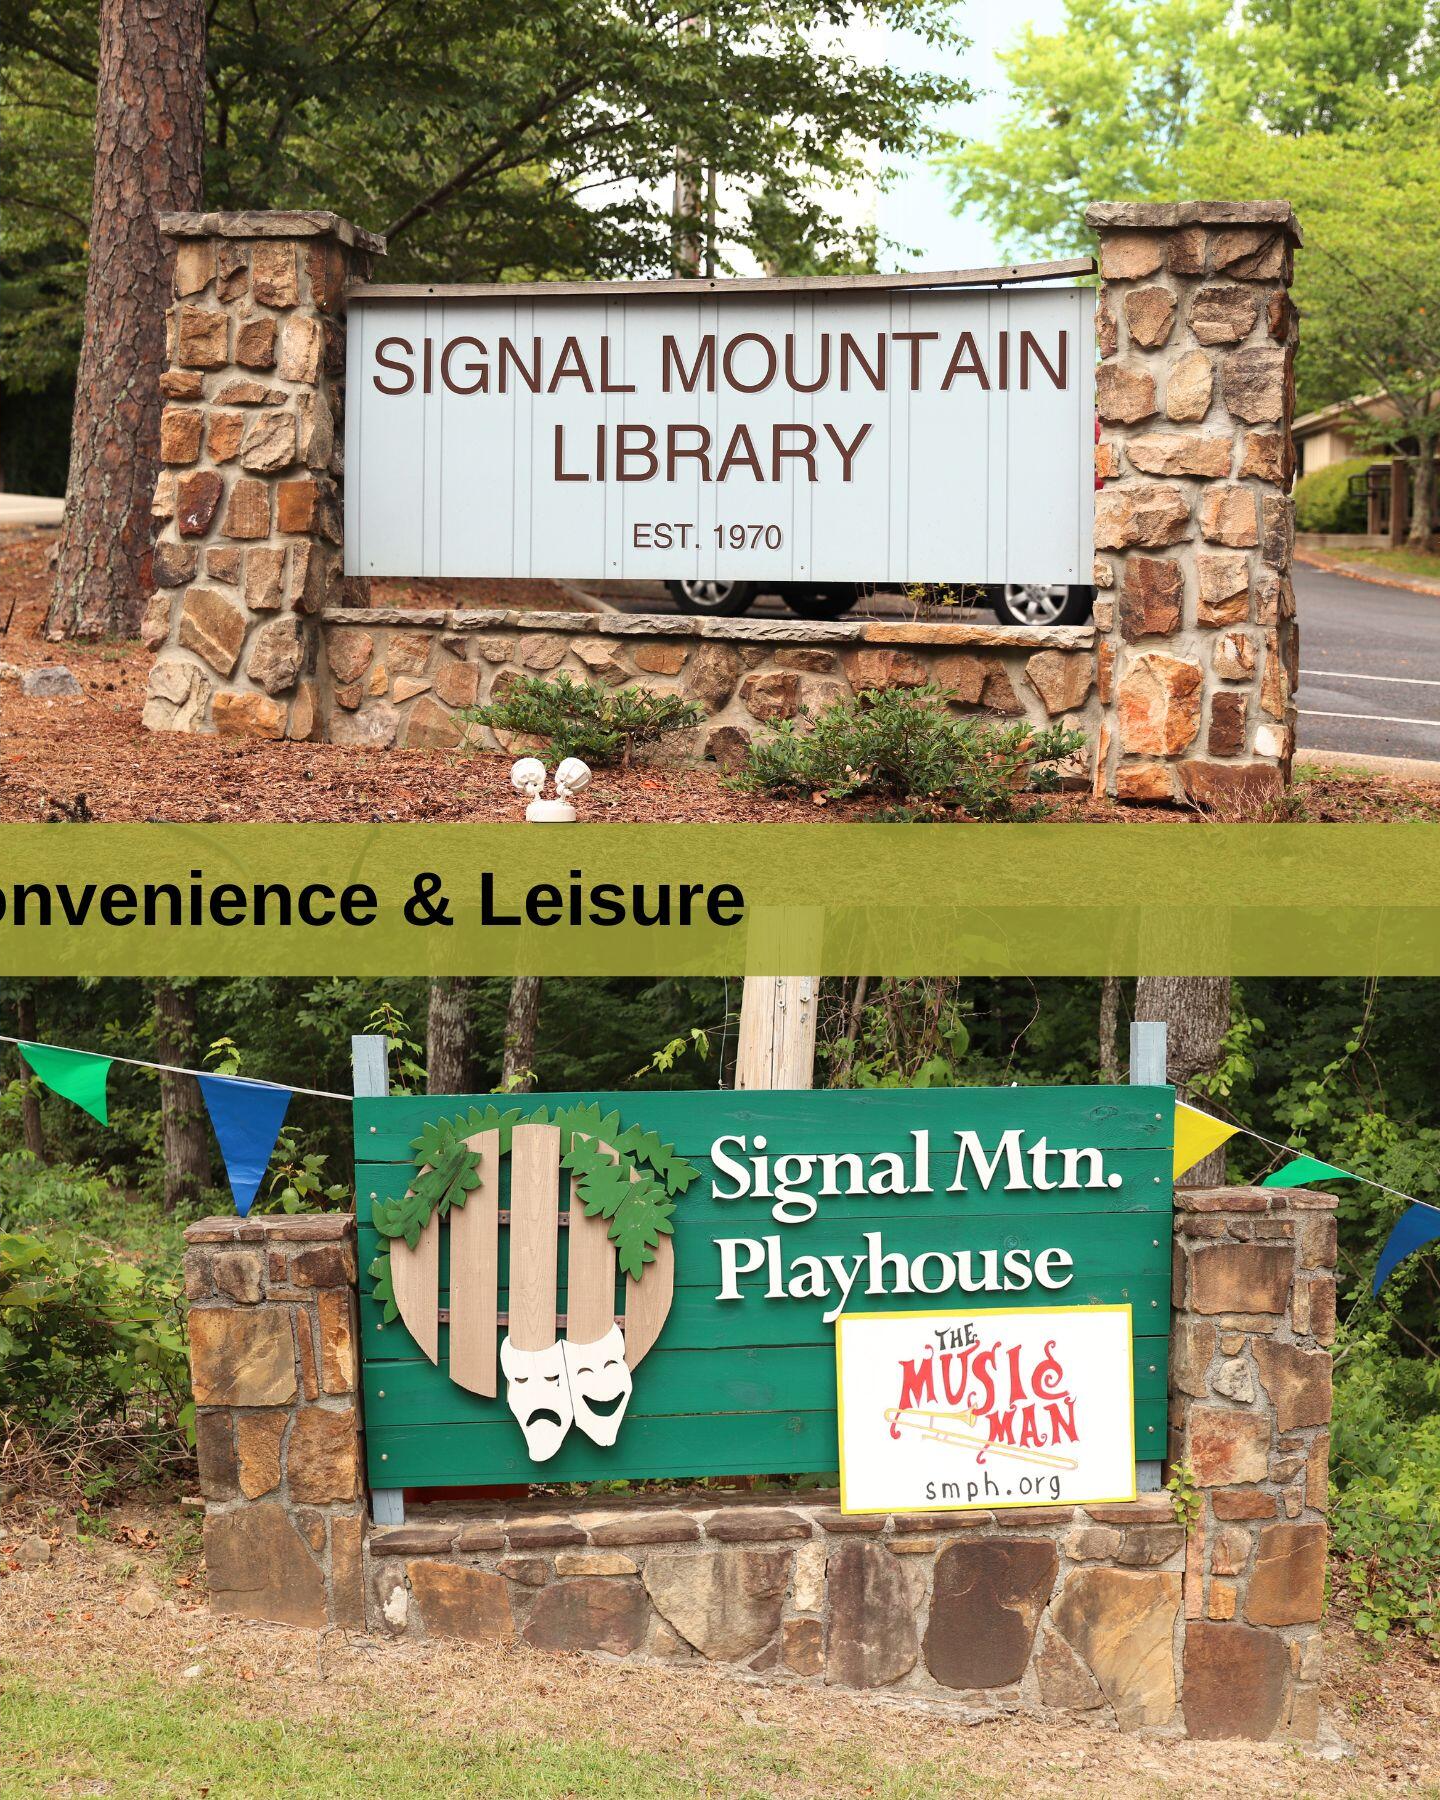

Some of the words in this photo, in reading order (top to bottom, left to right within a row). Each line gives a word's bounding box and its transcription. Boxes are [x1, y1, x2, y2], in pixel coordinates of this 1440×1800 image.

[372, 335, 636, 395] SIGNAL
[661, 330, 1069, 394] MOUNTAIN
[554, 423, 873, 482] LIBRARY
[633, 522, 701, 550] EST.
[713, 522, 783, 551] 1970
[710, 1129, 934, 1224] Signal
[946, 1129, 1123, 1193] Mtn.
[713, 1232, 1074, 1324] Playhouse
[935, 1322, 978, 1351] THE
[889, 1340, 1070, 1440] MUSIC
[976, 1395, 1080, 1465] MAN
[925, 1472, 1062, 1502] smph.org
